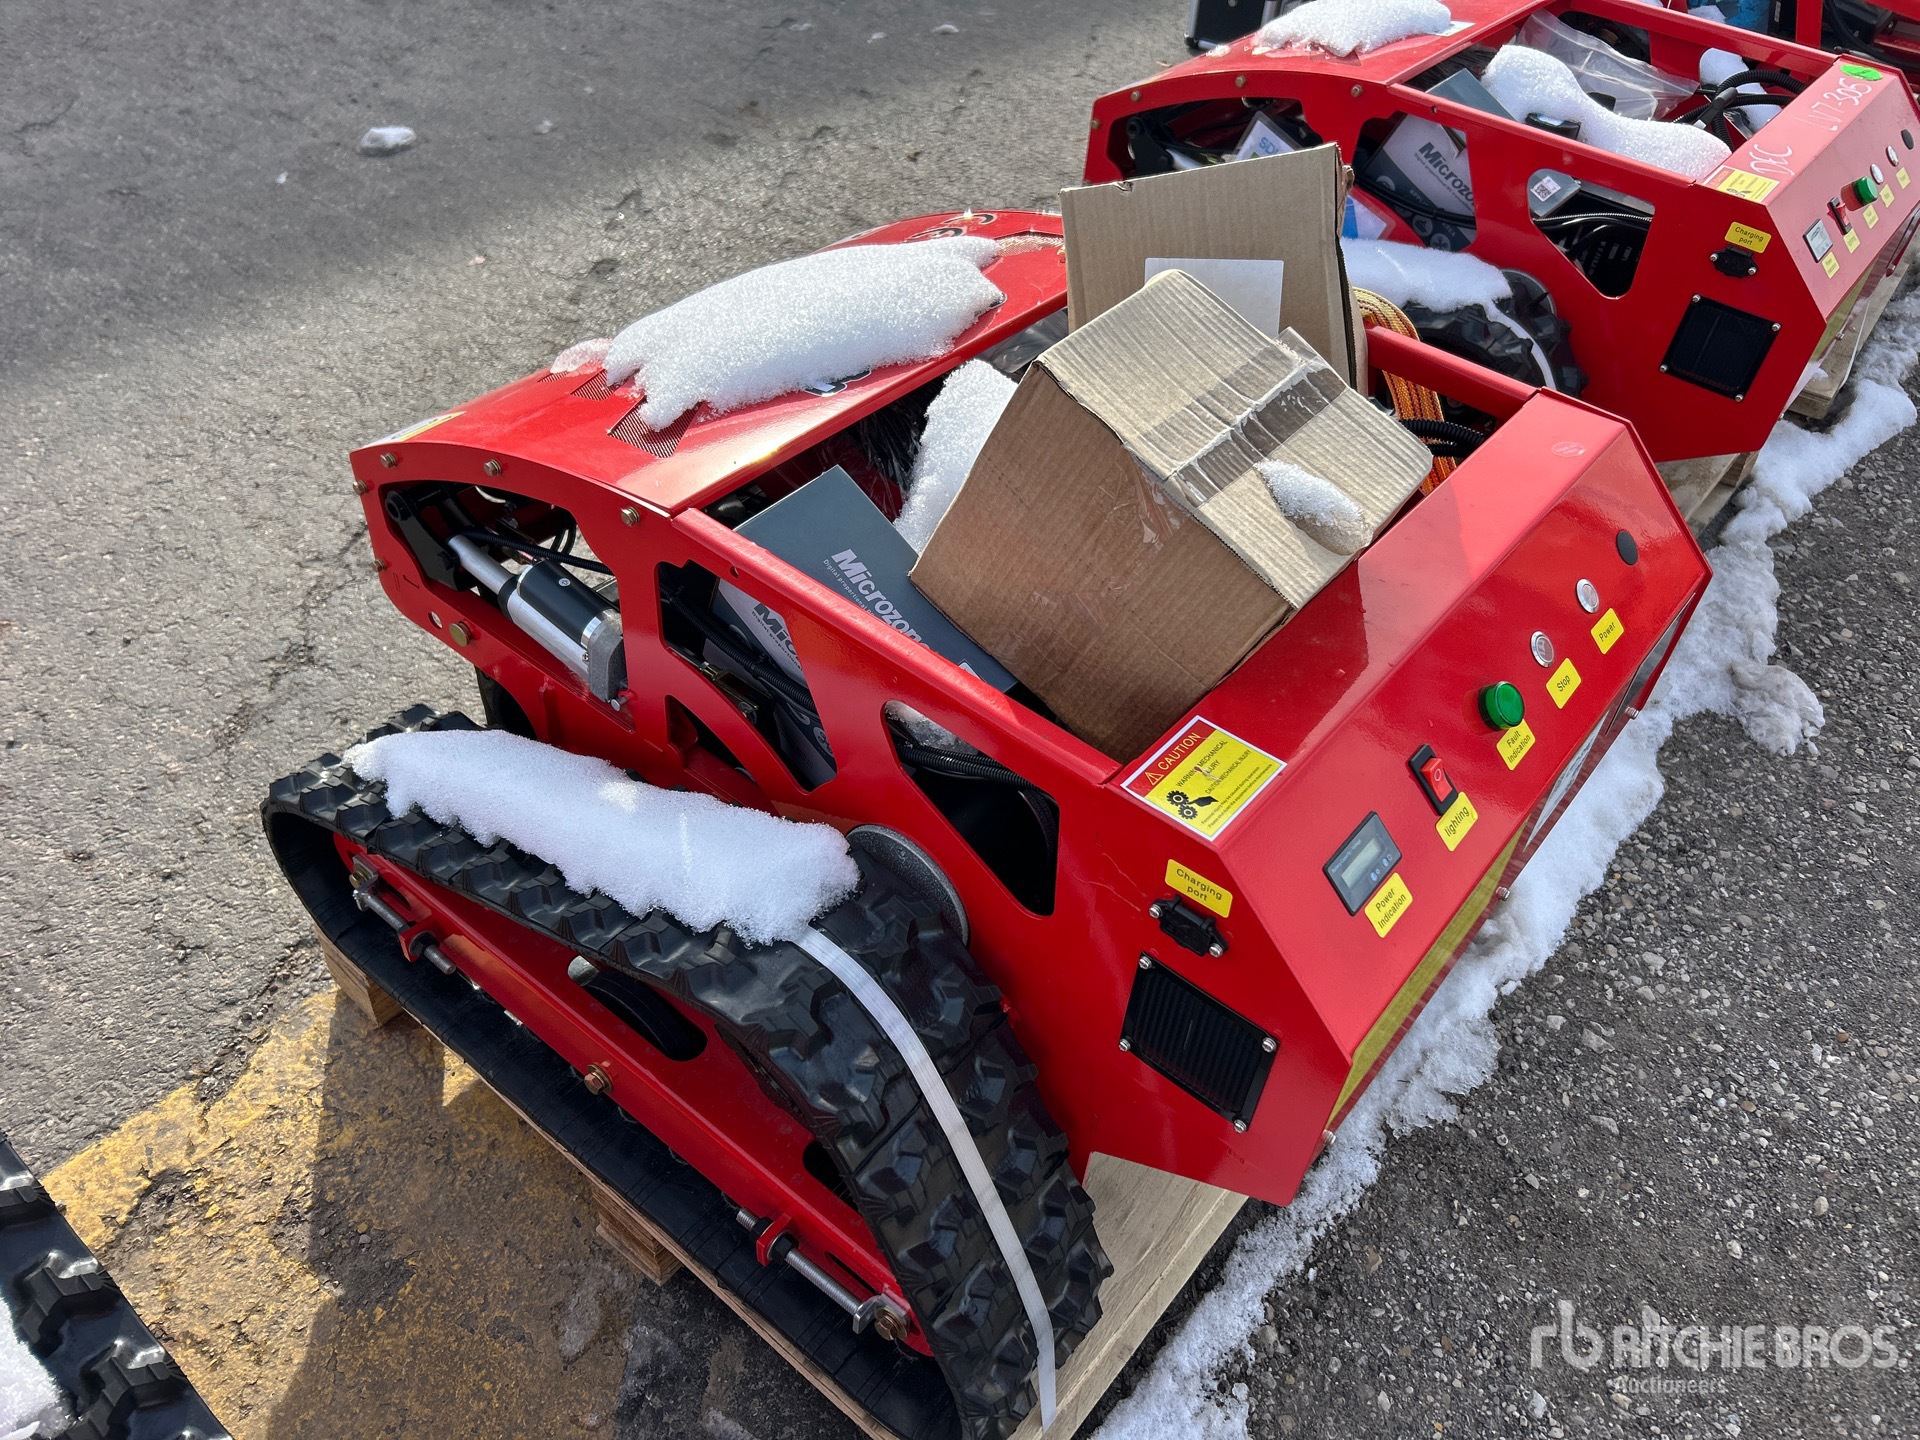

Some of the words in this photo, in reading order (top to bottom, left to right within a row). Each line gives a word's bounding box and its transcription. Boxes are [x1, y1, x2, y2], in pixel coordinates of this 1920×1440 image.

[1259, 137, 1279, 155] SD
[1418, 142, 1474, 205] Microzo
[1735, 226, 1764, 242] Charging
[1739, 237, 1752, 246] port
[822, 558, 840, 579] Digital
[831, 548, 930, 650] Microzon
[753, 602, 798, 660] Mic
[1599, 622, 1616, 642] Power
[1557, 675, 1570, 692] Stop
[1507, 730, 1520, 747] Fault
[1508, 734, 1530, 764] Indication
[1156, 732, 1202, 771] CAUTION
[1175, 765, 1200, 787] WARNIN
[1196, 739, 1228, 767] MECHANICAL
[1201, 759, 1221, 776] JURY
[1444, 806, 1470, 836] lighting
[1176, 868, 1222, 900] Charging
[1187, 886, 1208, 902] port
[1376, 888, 1395, 912] Power
[1378, 894, 1406, 928] Indication
